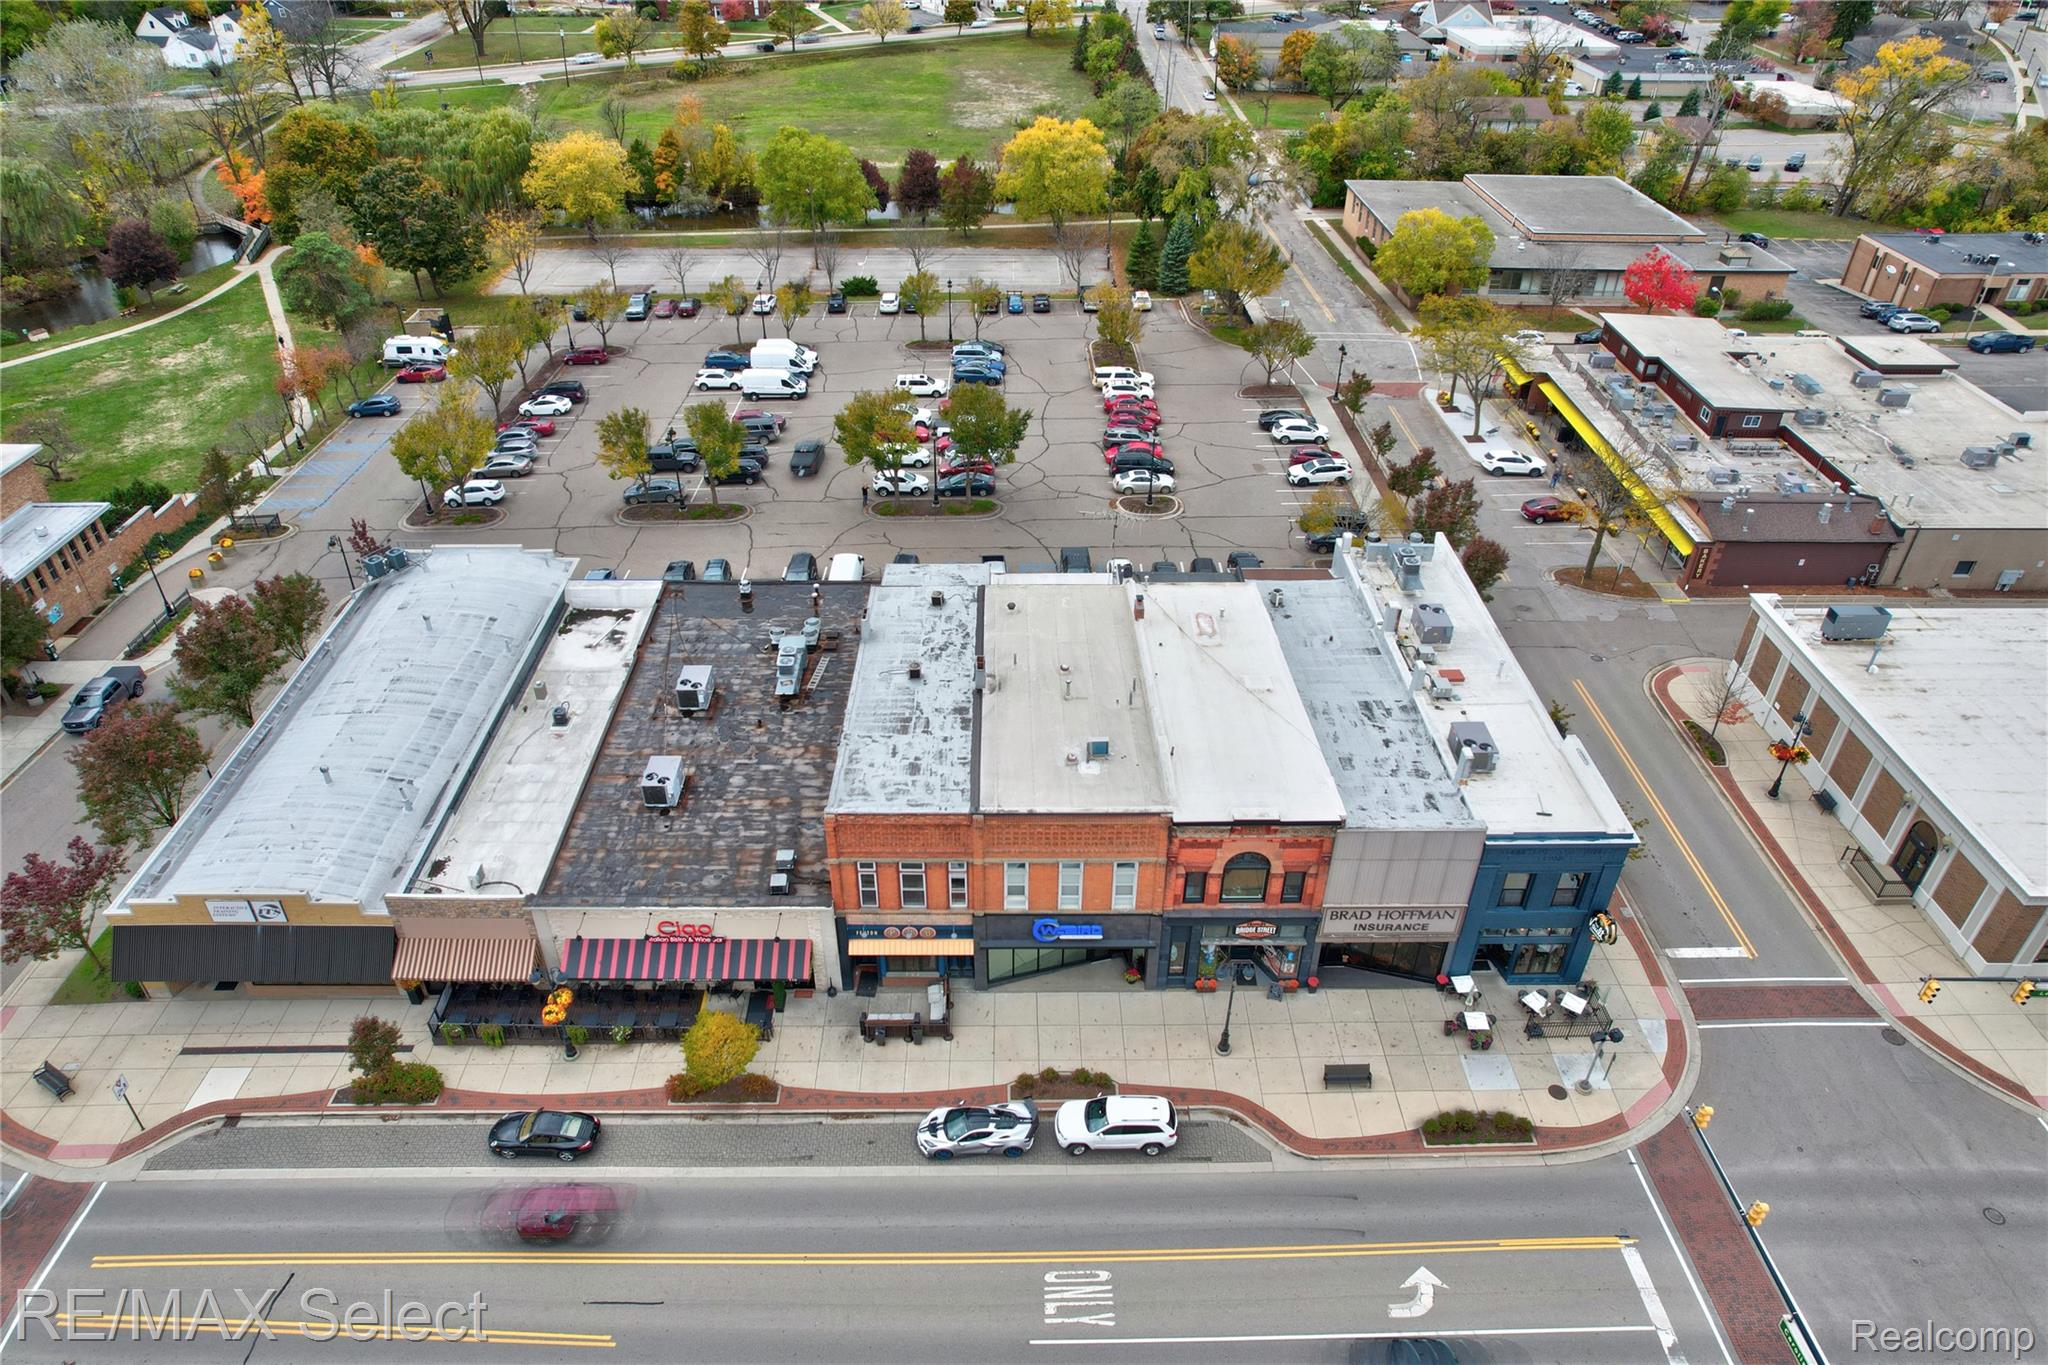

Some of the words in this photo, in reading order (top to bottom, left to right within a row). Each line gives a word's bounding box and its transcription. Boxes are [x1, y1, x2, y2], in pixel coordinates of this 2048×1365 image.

[1696, 548, 1709, 578] BAKERY
[1329, 910, 1372, 920] BRAD
[1377, 910, 1457, 920] HOFFMAN
[657, 920, 713, 936] Ciao
[1235, 926, 1256, 935] BRIDGE
[1257, 926, 1276, 935] STREET
[1353, 923, 1430, 932] INSURANCE
[1044, 1270, 1116, 1327] ONLY
